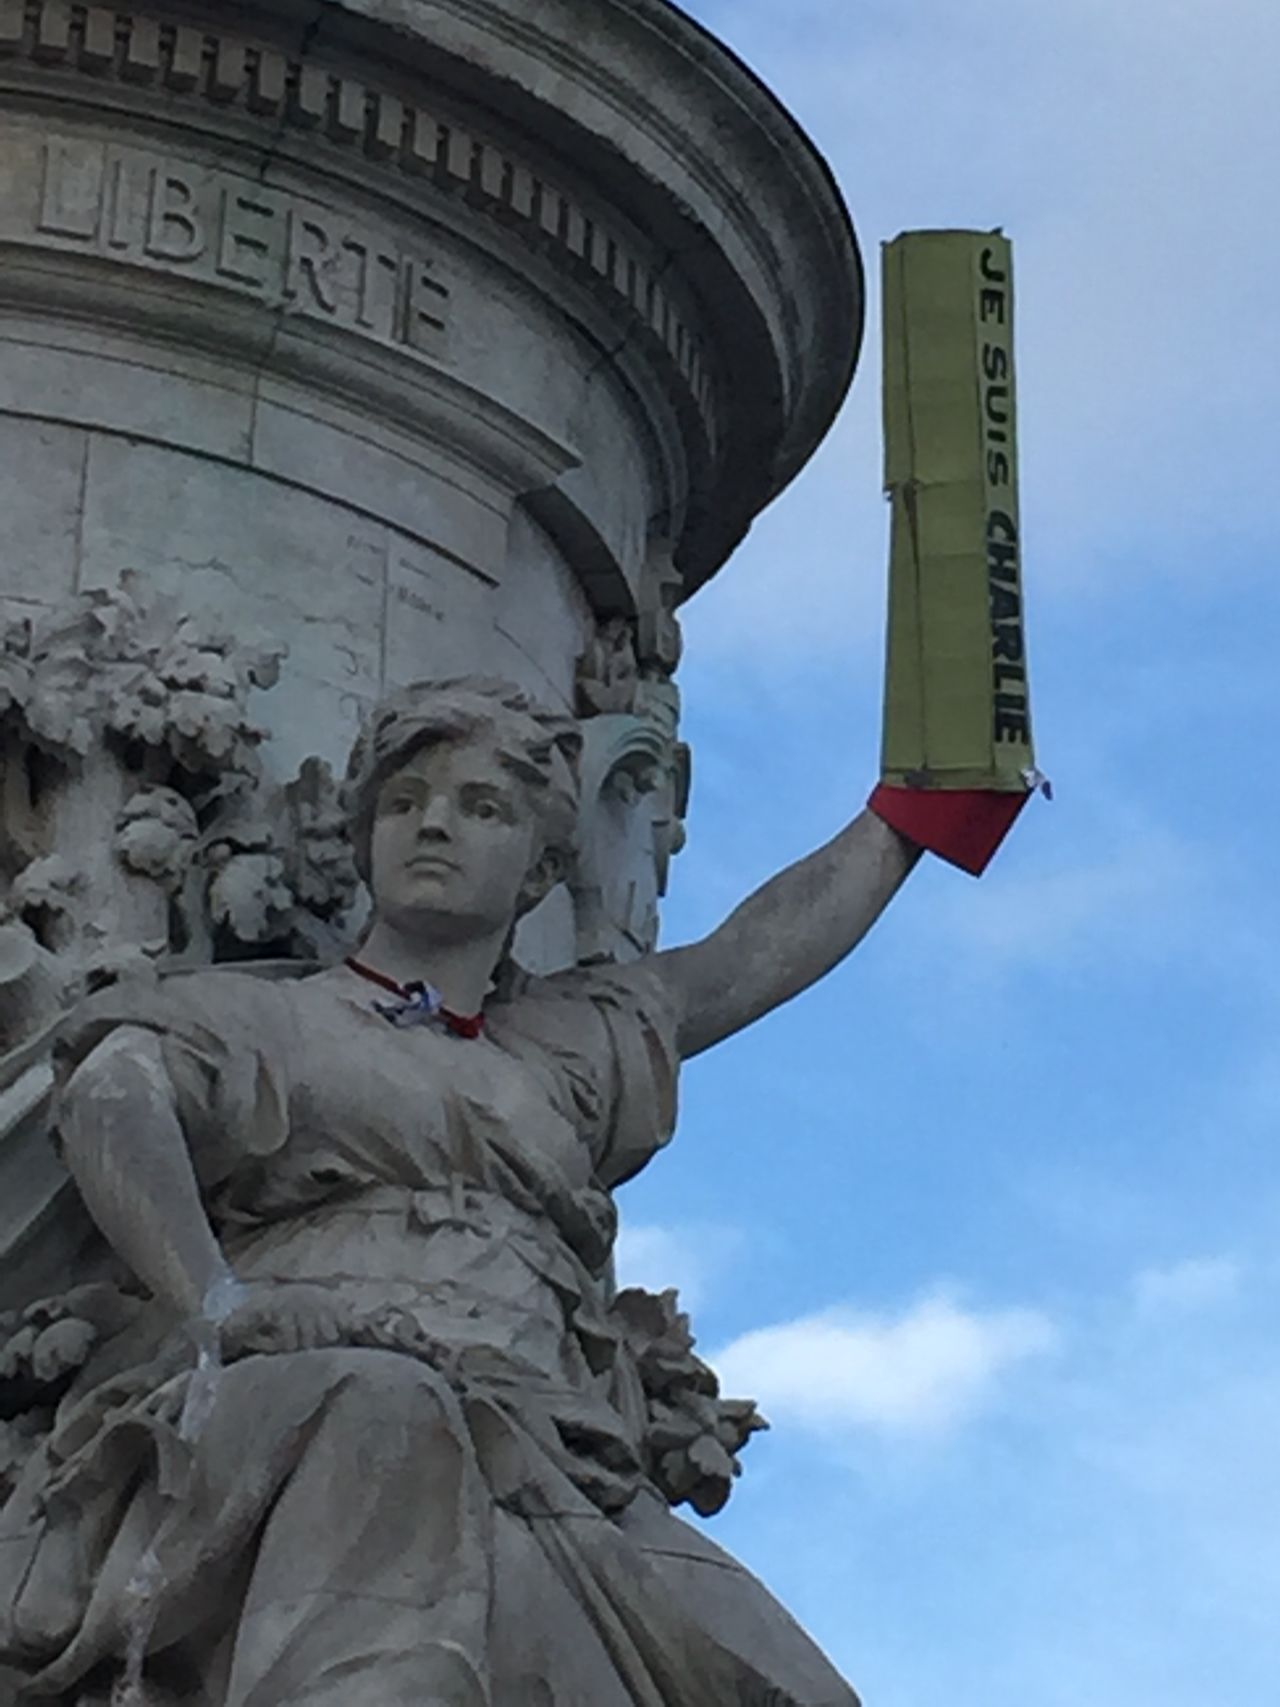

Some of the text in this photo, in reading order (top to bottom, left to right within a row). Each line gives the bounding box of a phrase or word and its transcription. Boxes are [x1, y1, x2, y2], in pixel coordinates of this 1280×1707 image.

[980, 248, 1029, 746] JE SUIS CHARLIE
